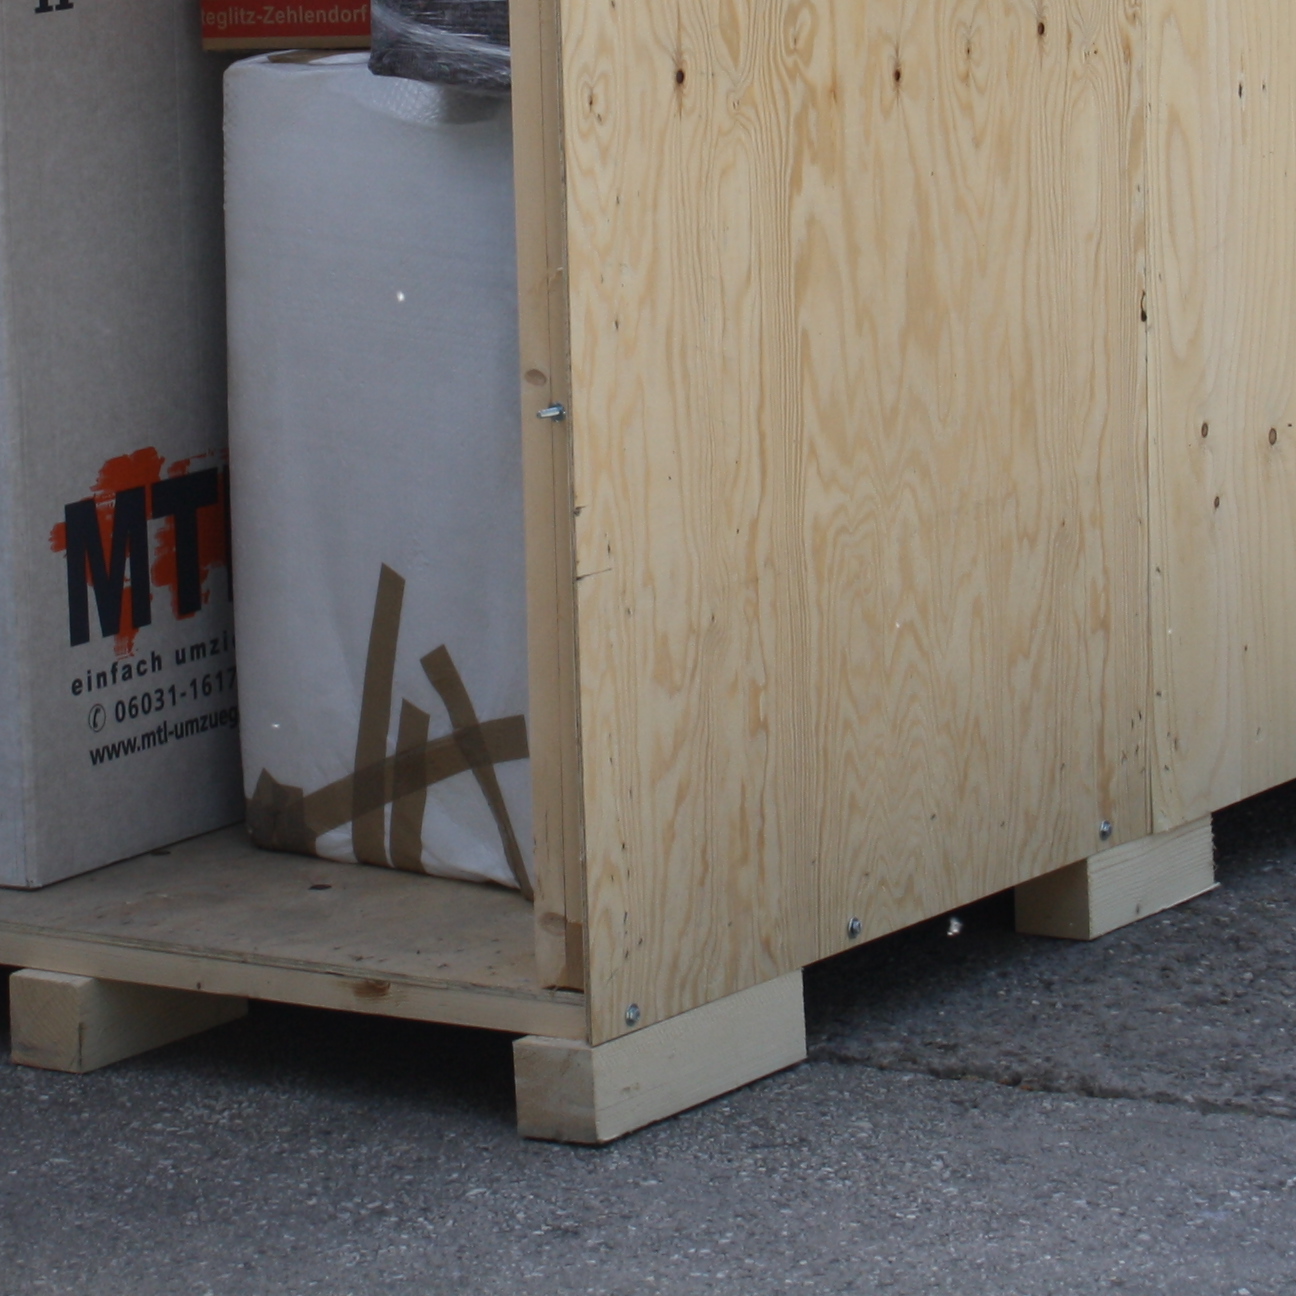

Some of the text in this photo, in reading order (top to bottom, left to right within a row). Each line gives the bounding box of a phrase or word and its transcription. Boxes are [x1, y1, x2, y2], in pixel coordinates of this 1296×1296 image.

[64, 465, 234, 648] MT
[71, 629, 238, 698] einfach umzi
